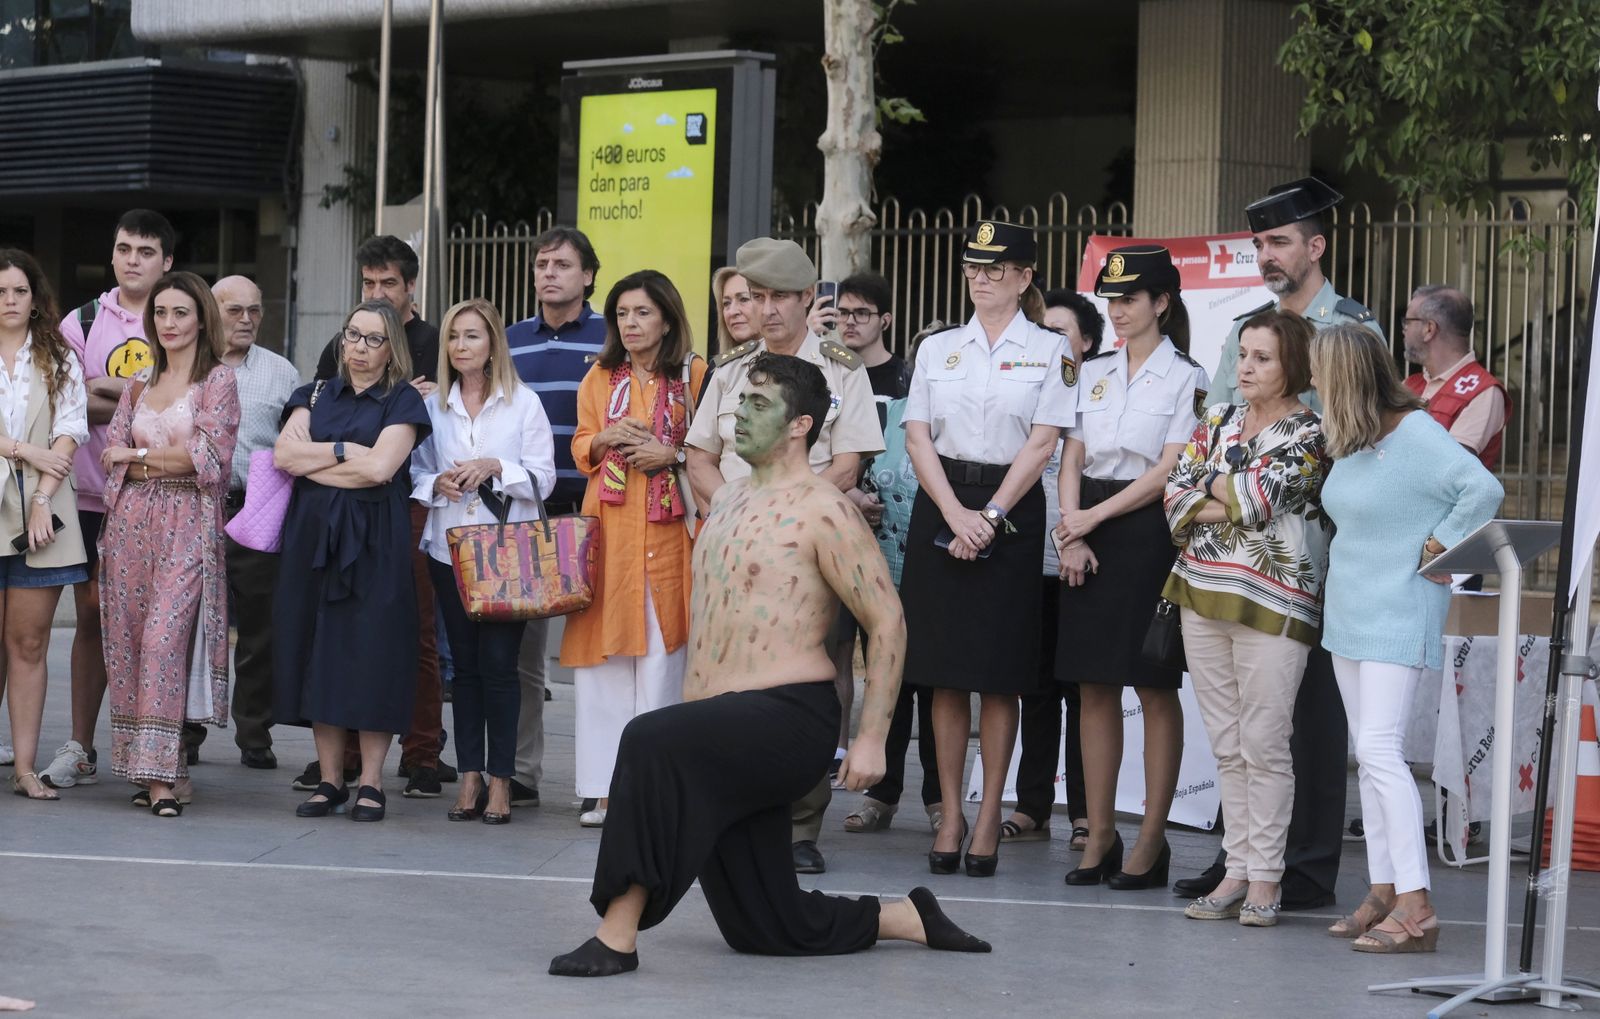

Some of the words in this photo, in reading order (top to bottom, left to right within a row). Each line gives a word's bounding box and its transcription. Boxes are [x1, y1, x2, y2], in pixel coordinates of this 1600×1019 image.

[626, 147, 666, 163] euros
[590, 174, 615, 192] dan
[619, 175, 650, 196] para
[589, 199, 643, 220] mucho!
[1181, 256, 1208, 267] personas
[1235, 252, 1254, 264] Cruz
[1454, 641, 1471, 668] Cruz
[1188, 779, 1215, 795] Española
